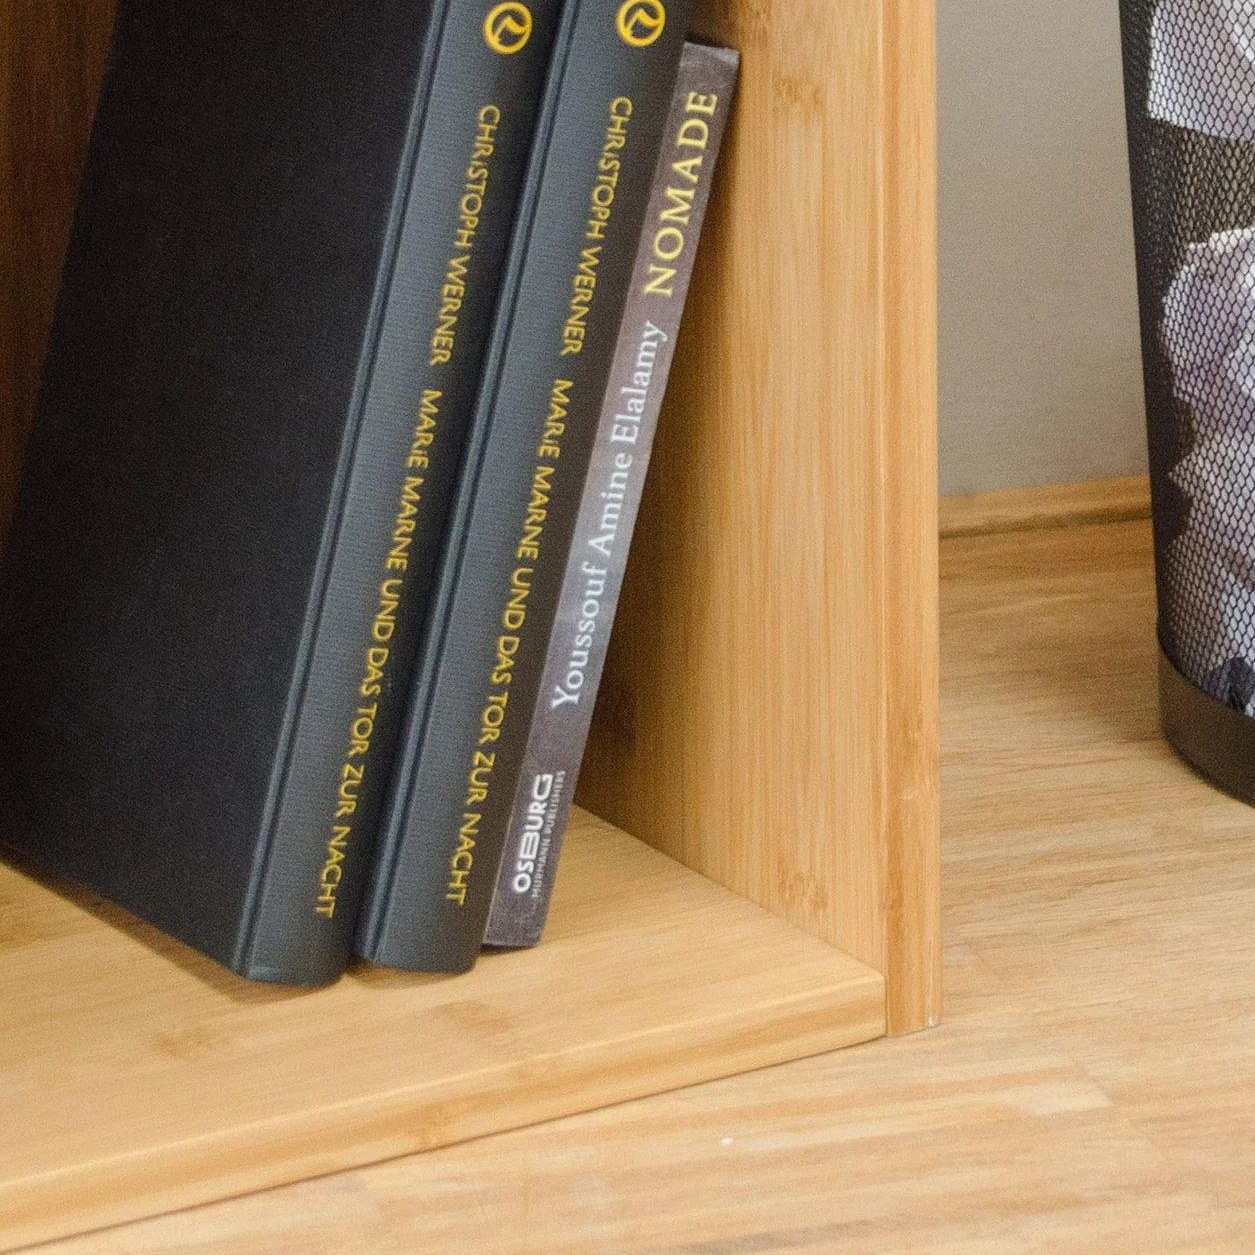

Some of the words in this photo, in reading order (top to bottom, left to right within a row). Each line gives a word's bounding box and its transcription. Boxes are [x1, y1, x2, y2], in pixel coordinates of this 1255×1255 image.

[429, 254, 470, 366] WERNER
[560, 246, 602, 356] WERNER
[552, 562, 607, 709] Youssouf
[588, 452, 632, 555] Amine
[610, 321, 668, 444] Elalamy
[643, 91, 718, 297] NOMADE
[384, 475, 424, 570] MARNE
[515, 465, 555, 560] MARNE
[371, 578, 403, 642] UND
[503, 567, 533, 630] UND
[360, 647, 389, 697] DAS
[490, 635, 520, 685] DAS
[348, 703, 377, 756] TOR
[478, 691, 508, 744] TOR
[335, 763, 364, 818] ZUR
[465, 751, 496, 806] ZUR
[315, 825, 351, 918] NACHT
[446, 812, 482, 906] NACHT
[513, 773, 553, 893] OSBURG
